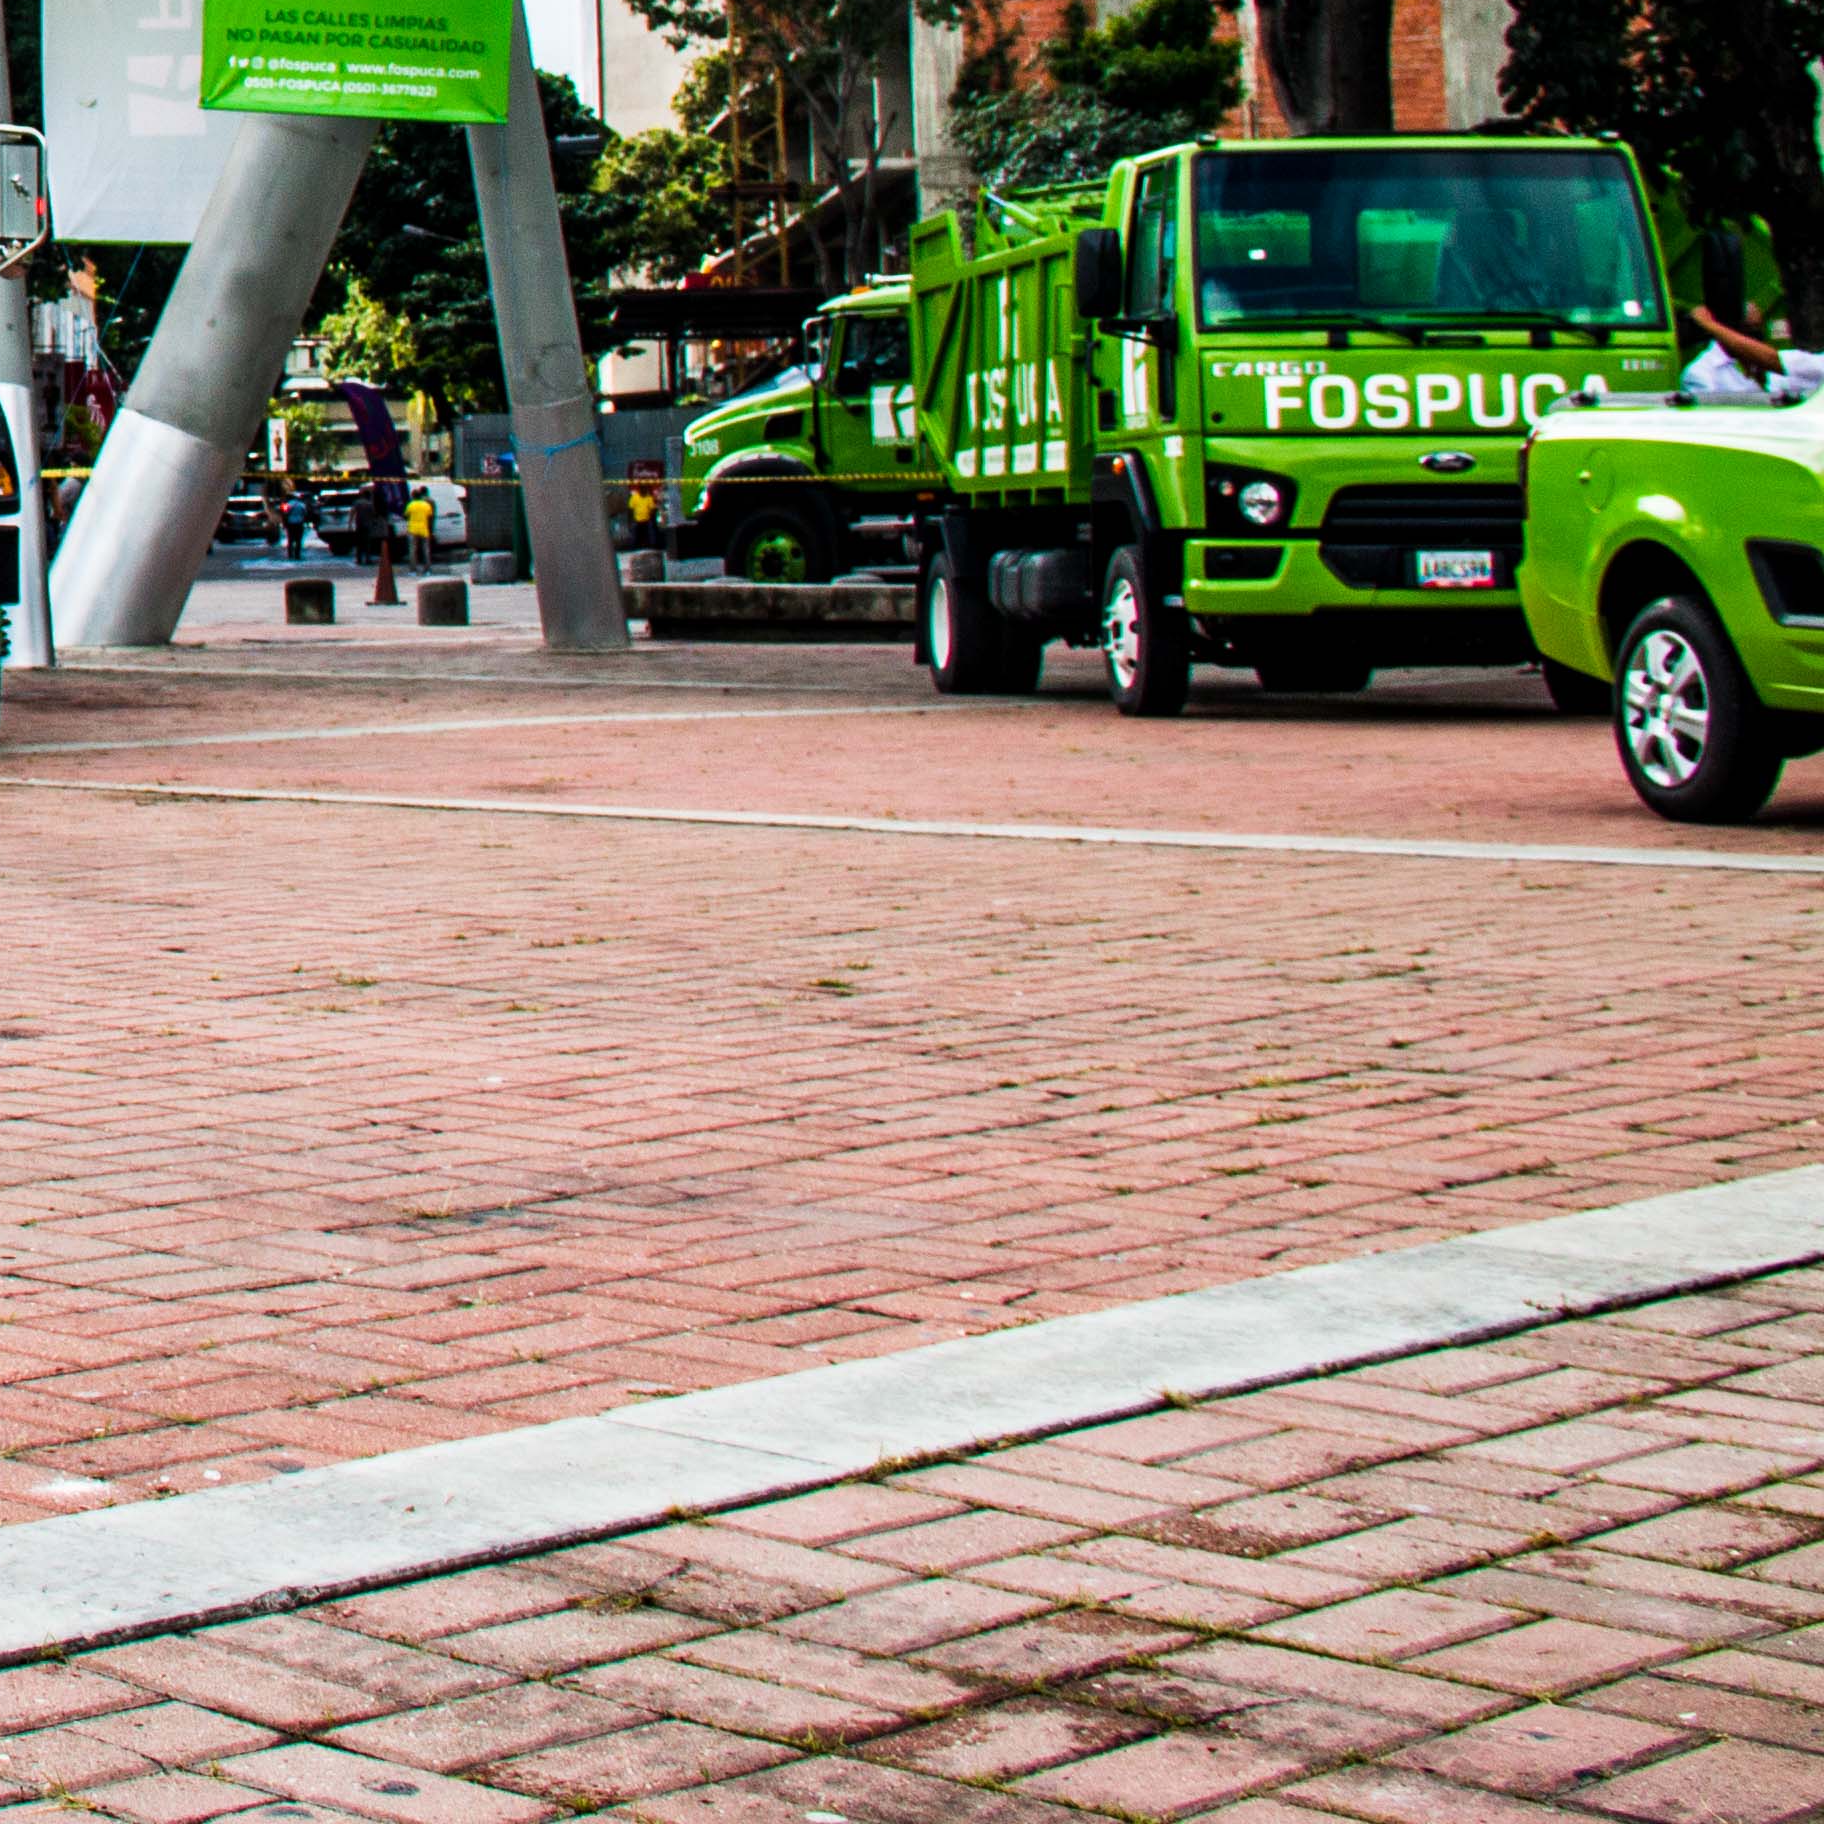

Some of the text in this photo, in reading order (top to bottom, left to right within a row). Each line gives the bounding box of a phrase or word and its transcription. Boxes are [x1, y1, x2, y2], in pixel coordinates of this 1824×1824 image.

[264, 9, 449, 32] LAS CALLES LIMPIAS
[226, 28, 486, 54] NO PASAN POR CASUALIDAD
[267, 57, 481, 80] @fospuca www.fospuca.com
[1211, 360, 1328, 377] CARGO
